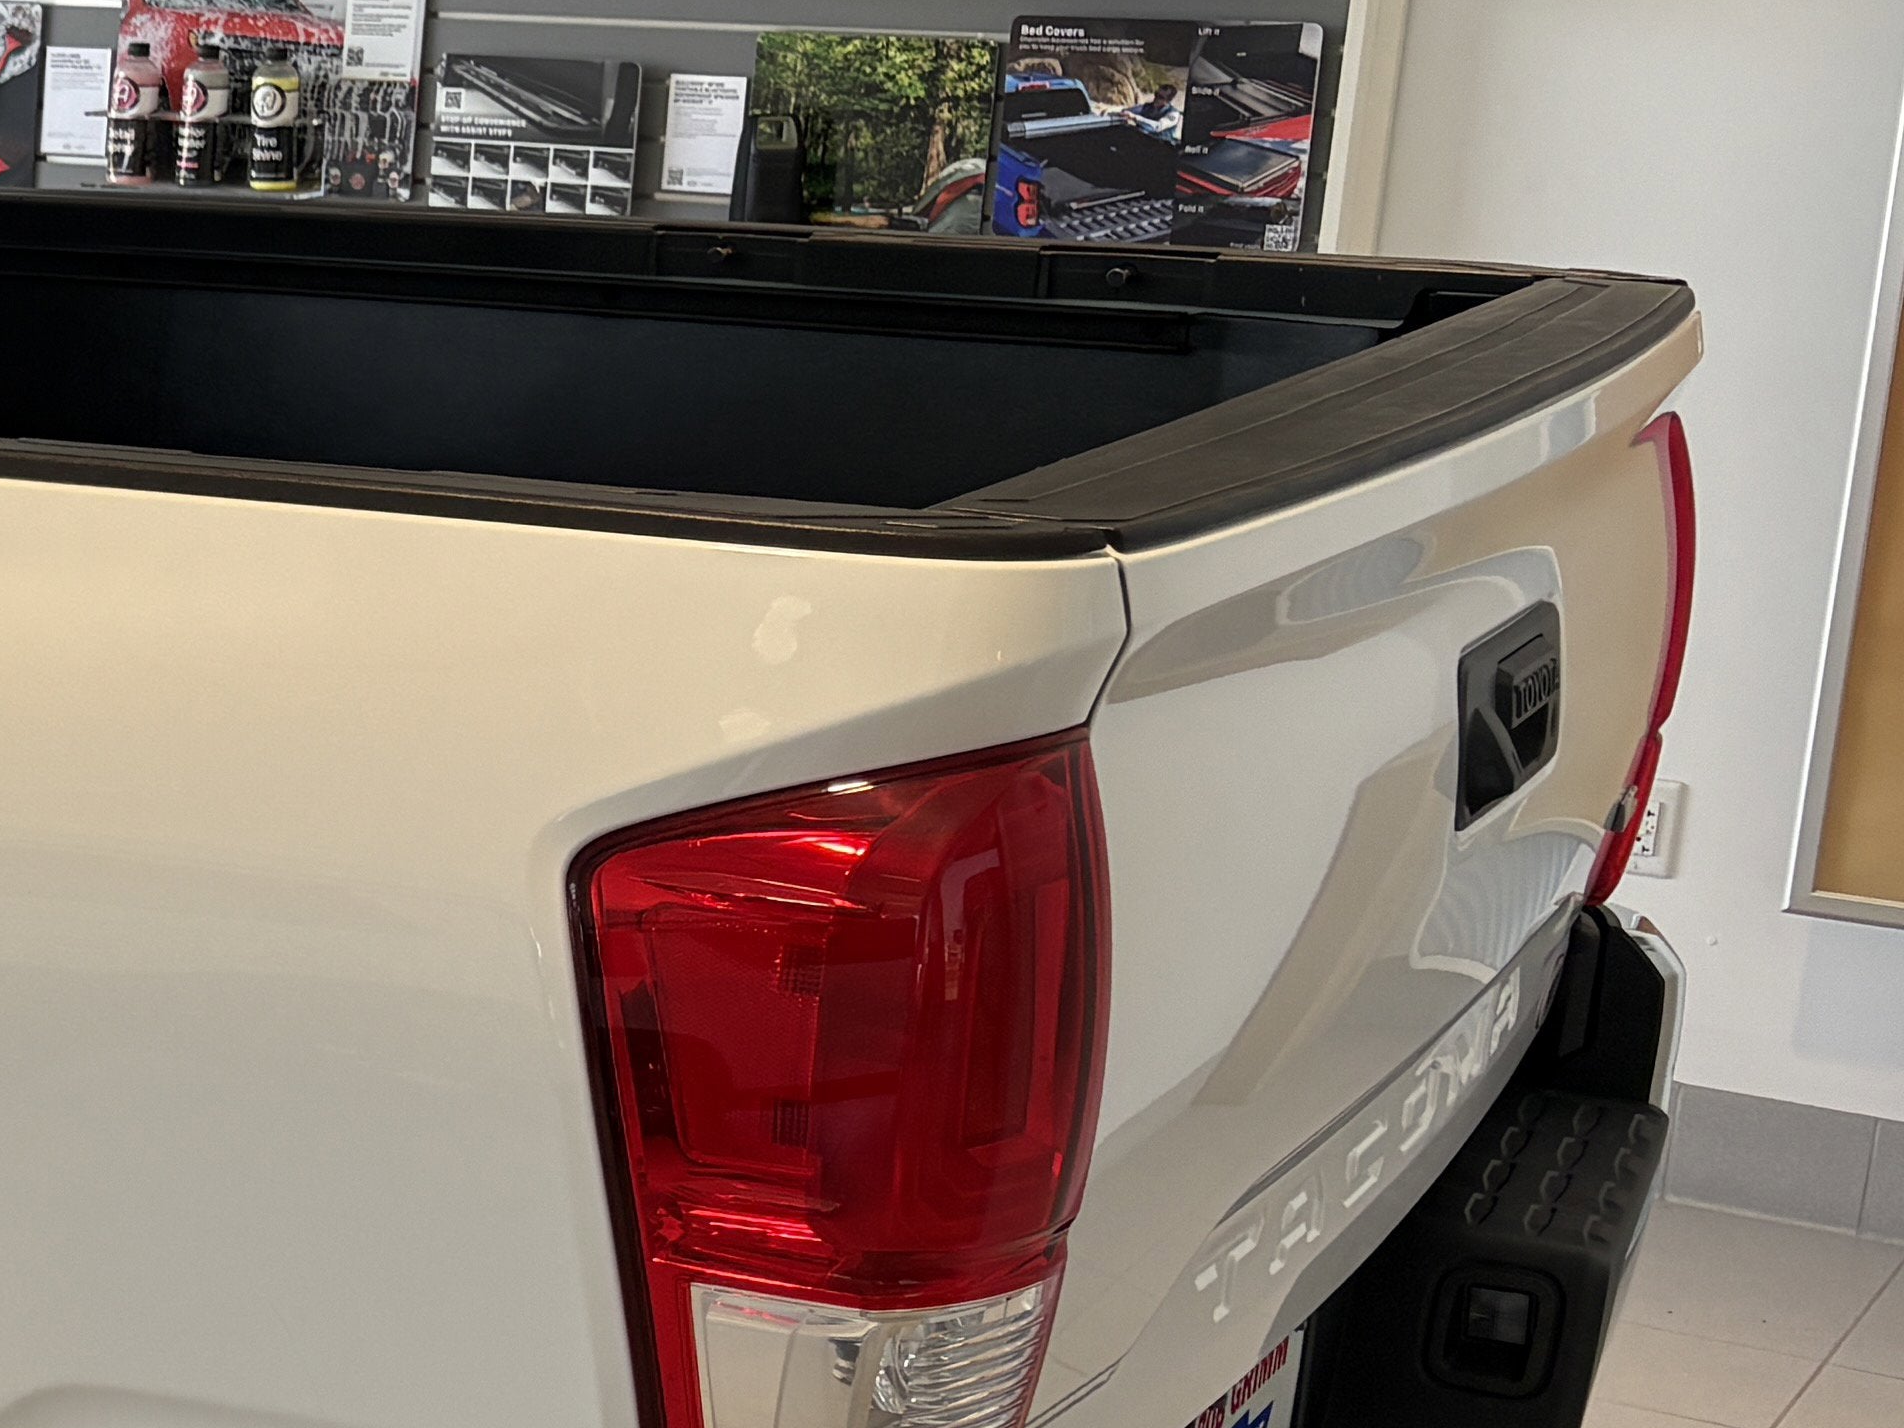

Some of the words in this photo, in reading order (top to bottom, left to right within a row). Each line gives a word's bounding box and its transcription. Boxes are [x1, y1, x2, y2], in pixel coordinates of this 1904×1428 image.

[1021, 24, 1043, 36] Bed
[1045, 25, 1085, 37] Covers
[254, 132, 278, 148] Tire
[253, 147, 283, 162] Shine
[1194, 965, 1521, 1324] TACOMA
